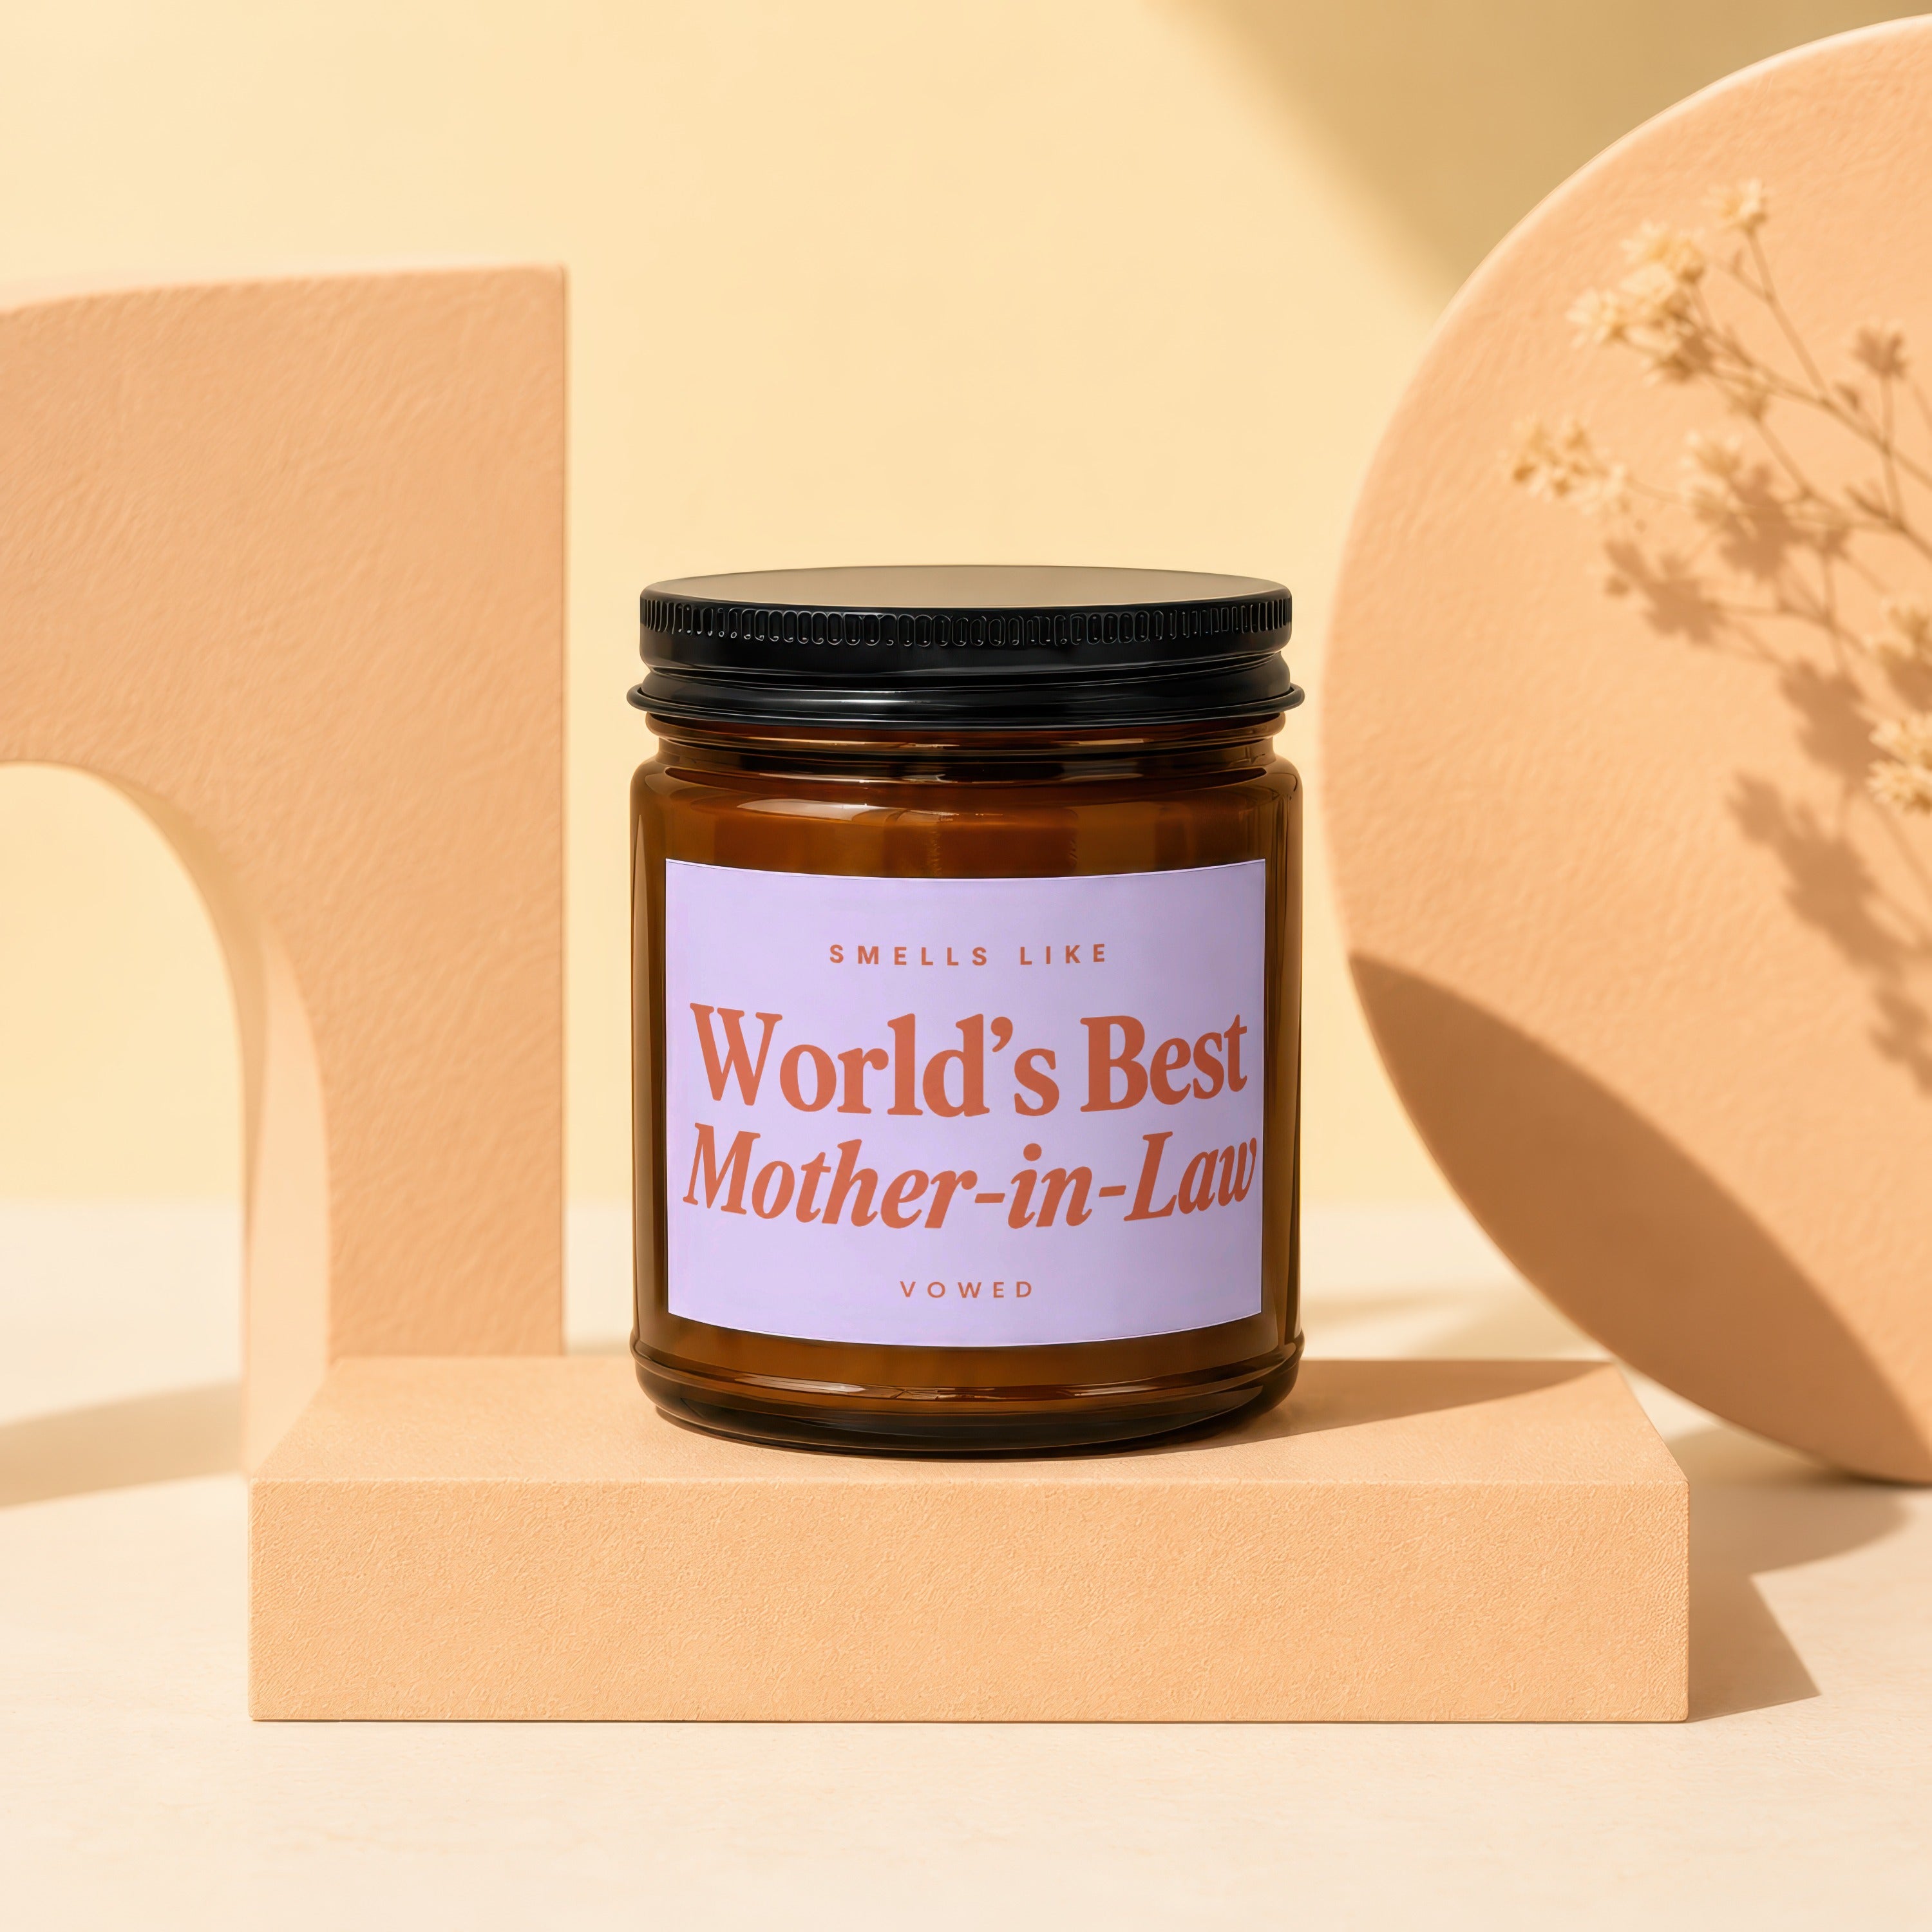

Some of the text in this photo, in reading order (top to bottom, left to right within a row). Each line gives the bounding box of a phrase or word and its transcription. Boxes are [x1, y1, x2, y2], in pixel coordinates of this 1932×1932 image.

[828, 942, 1107, 967] SMELLS LIKE
[1079, 1012, 1250, 1113] Best
[681, 1122, 1258, 1231] Mother-in-Law
[899, 1279, 1034, 1300] VOWED
